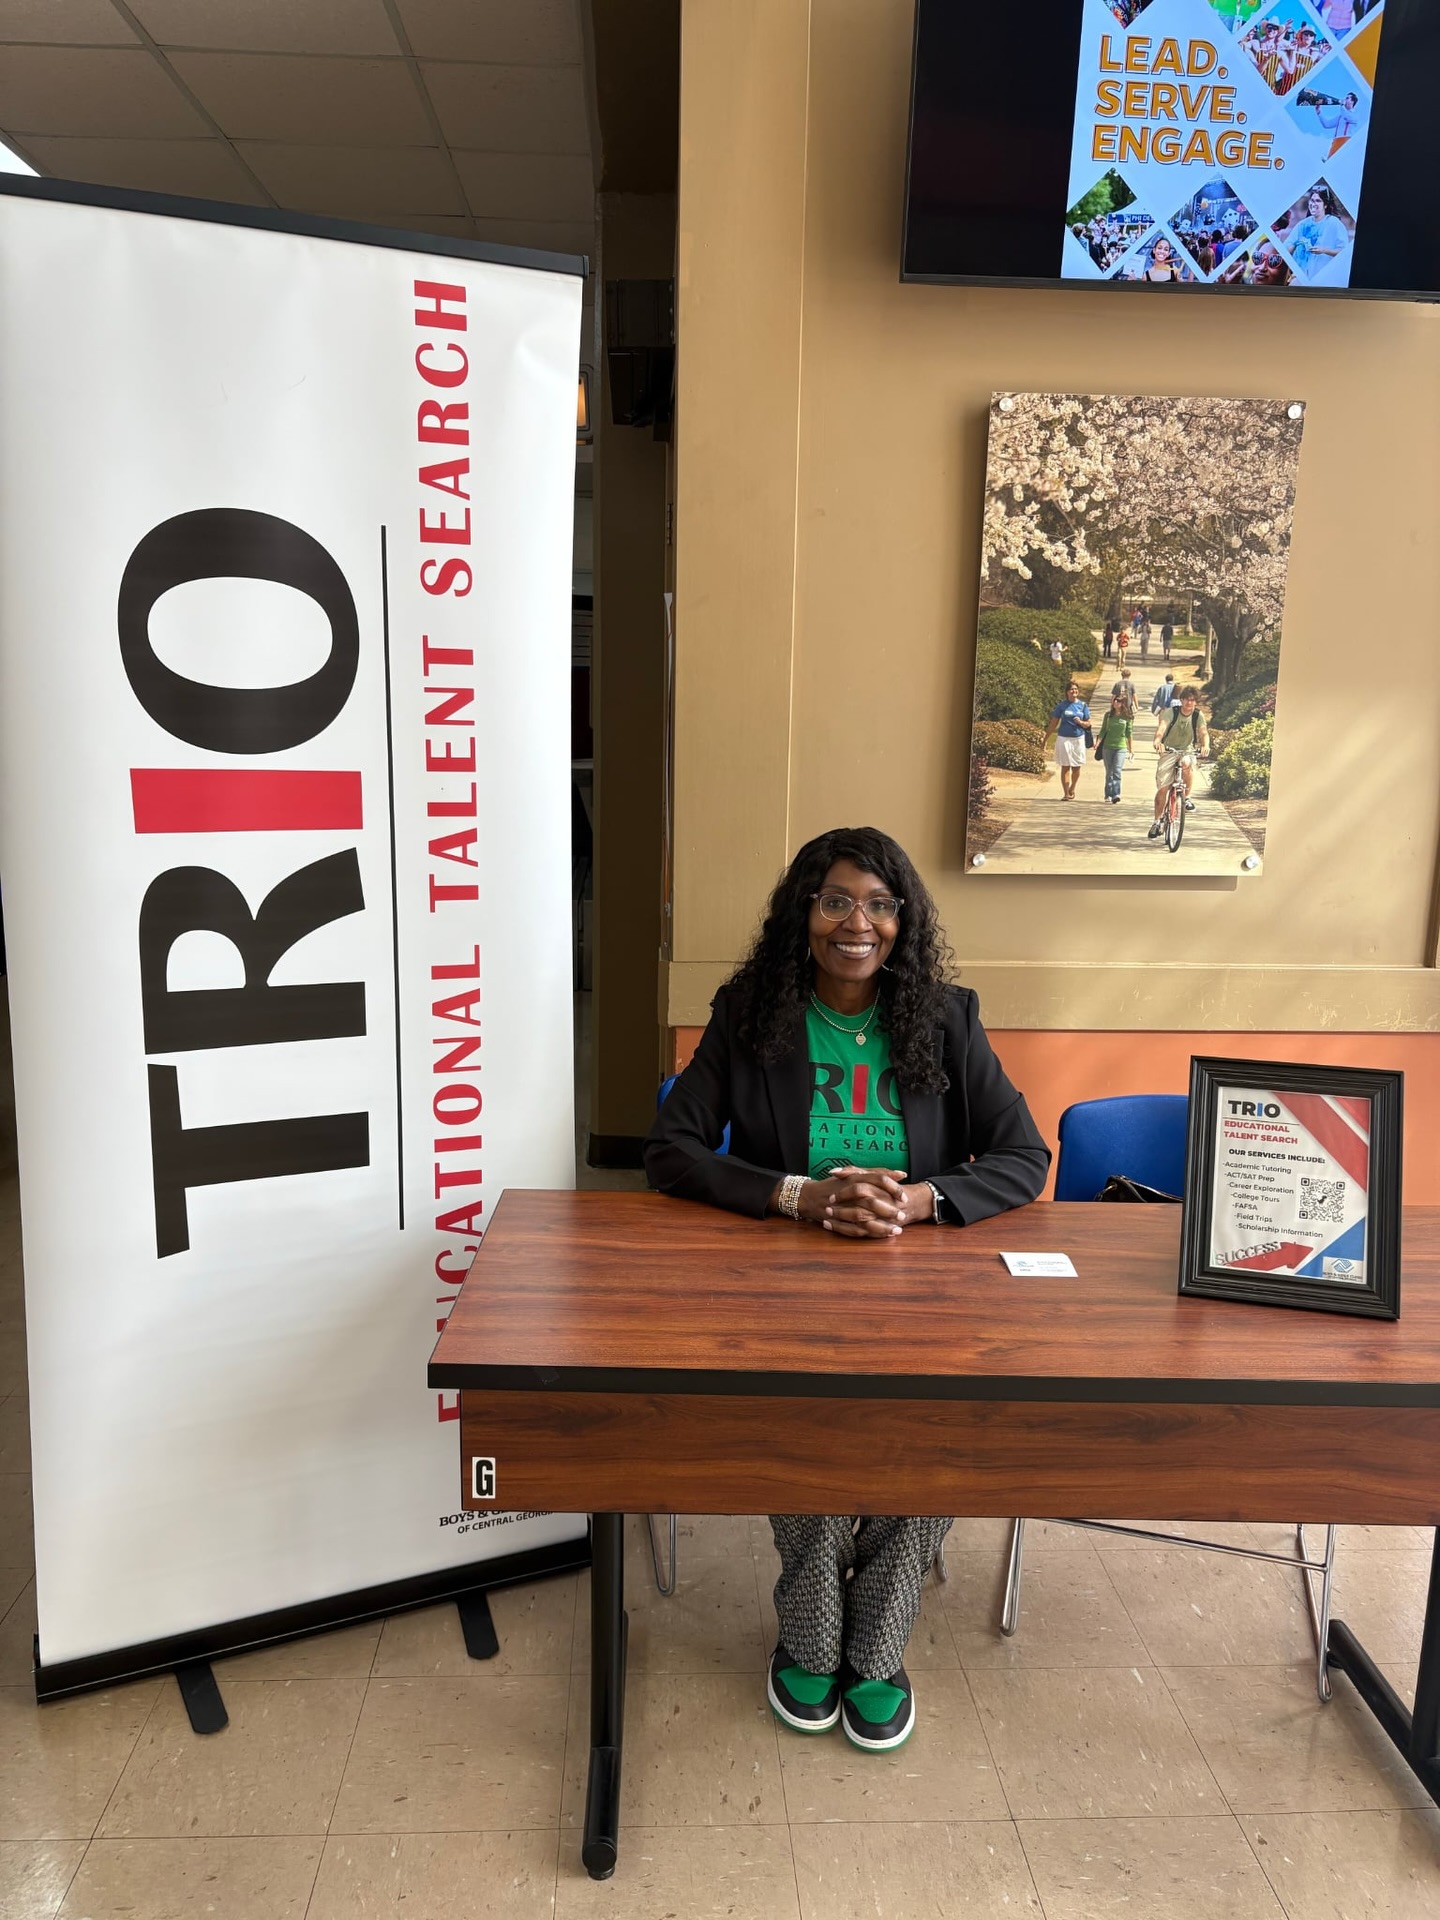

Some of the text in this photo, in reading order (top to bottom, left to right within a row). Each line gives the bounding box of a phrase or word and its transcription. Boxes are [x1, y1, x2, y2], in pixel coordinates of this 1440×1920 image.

[1098, 34, 1228, 79] LEAD.
[1094, 79, 1248, 124] SERVE.
[1092, 124, 1285, 170] ENGAGE.
[414, 280, 483, 1422] CATIONAL TALENT SEARCH
[117, 507, 370, 1258] TRIO
[809, 1062, 904, 1116] RIO
[1228, 1100, 1281, 1118] TRIO
[1224, 1120, 1290, 1133] EDUCATIONAL
[1223, 1131, 1298, 1144] TALENT SEARCH
[1228, 1148, 1326, 1164] OUR SERVICES INCLUDE:
[1261, 1164, 1292, 1174] Tutoring
[1258, 1174, 1275, 1183] Prep
[1253, 1184, 1294, 1194] Exploration
[1260, 1195, 1280, 1203] Tours
[1255, 1215, 1273, 1223] Trips
[1280, 1228, 1324, 1238] Information
[1215, 1241, 1279, 1265] SUCCESS
[475, 1459, 493, 1496] G
[439, 1511, 474, 1527] BOYS
[457, 1525, 471, 1534] OF
[472, 1515, 514, 1531] CENTRAL
[516, 1511, 554, 1521] GEORG
